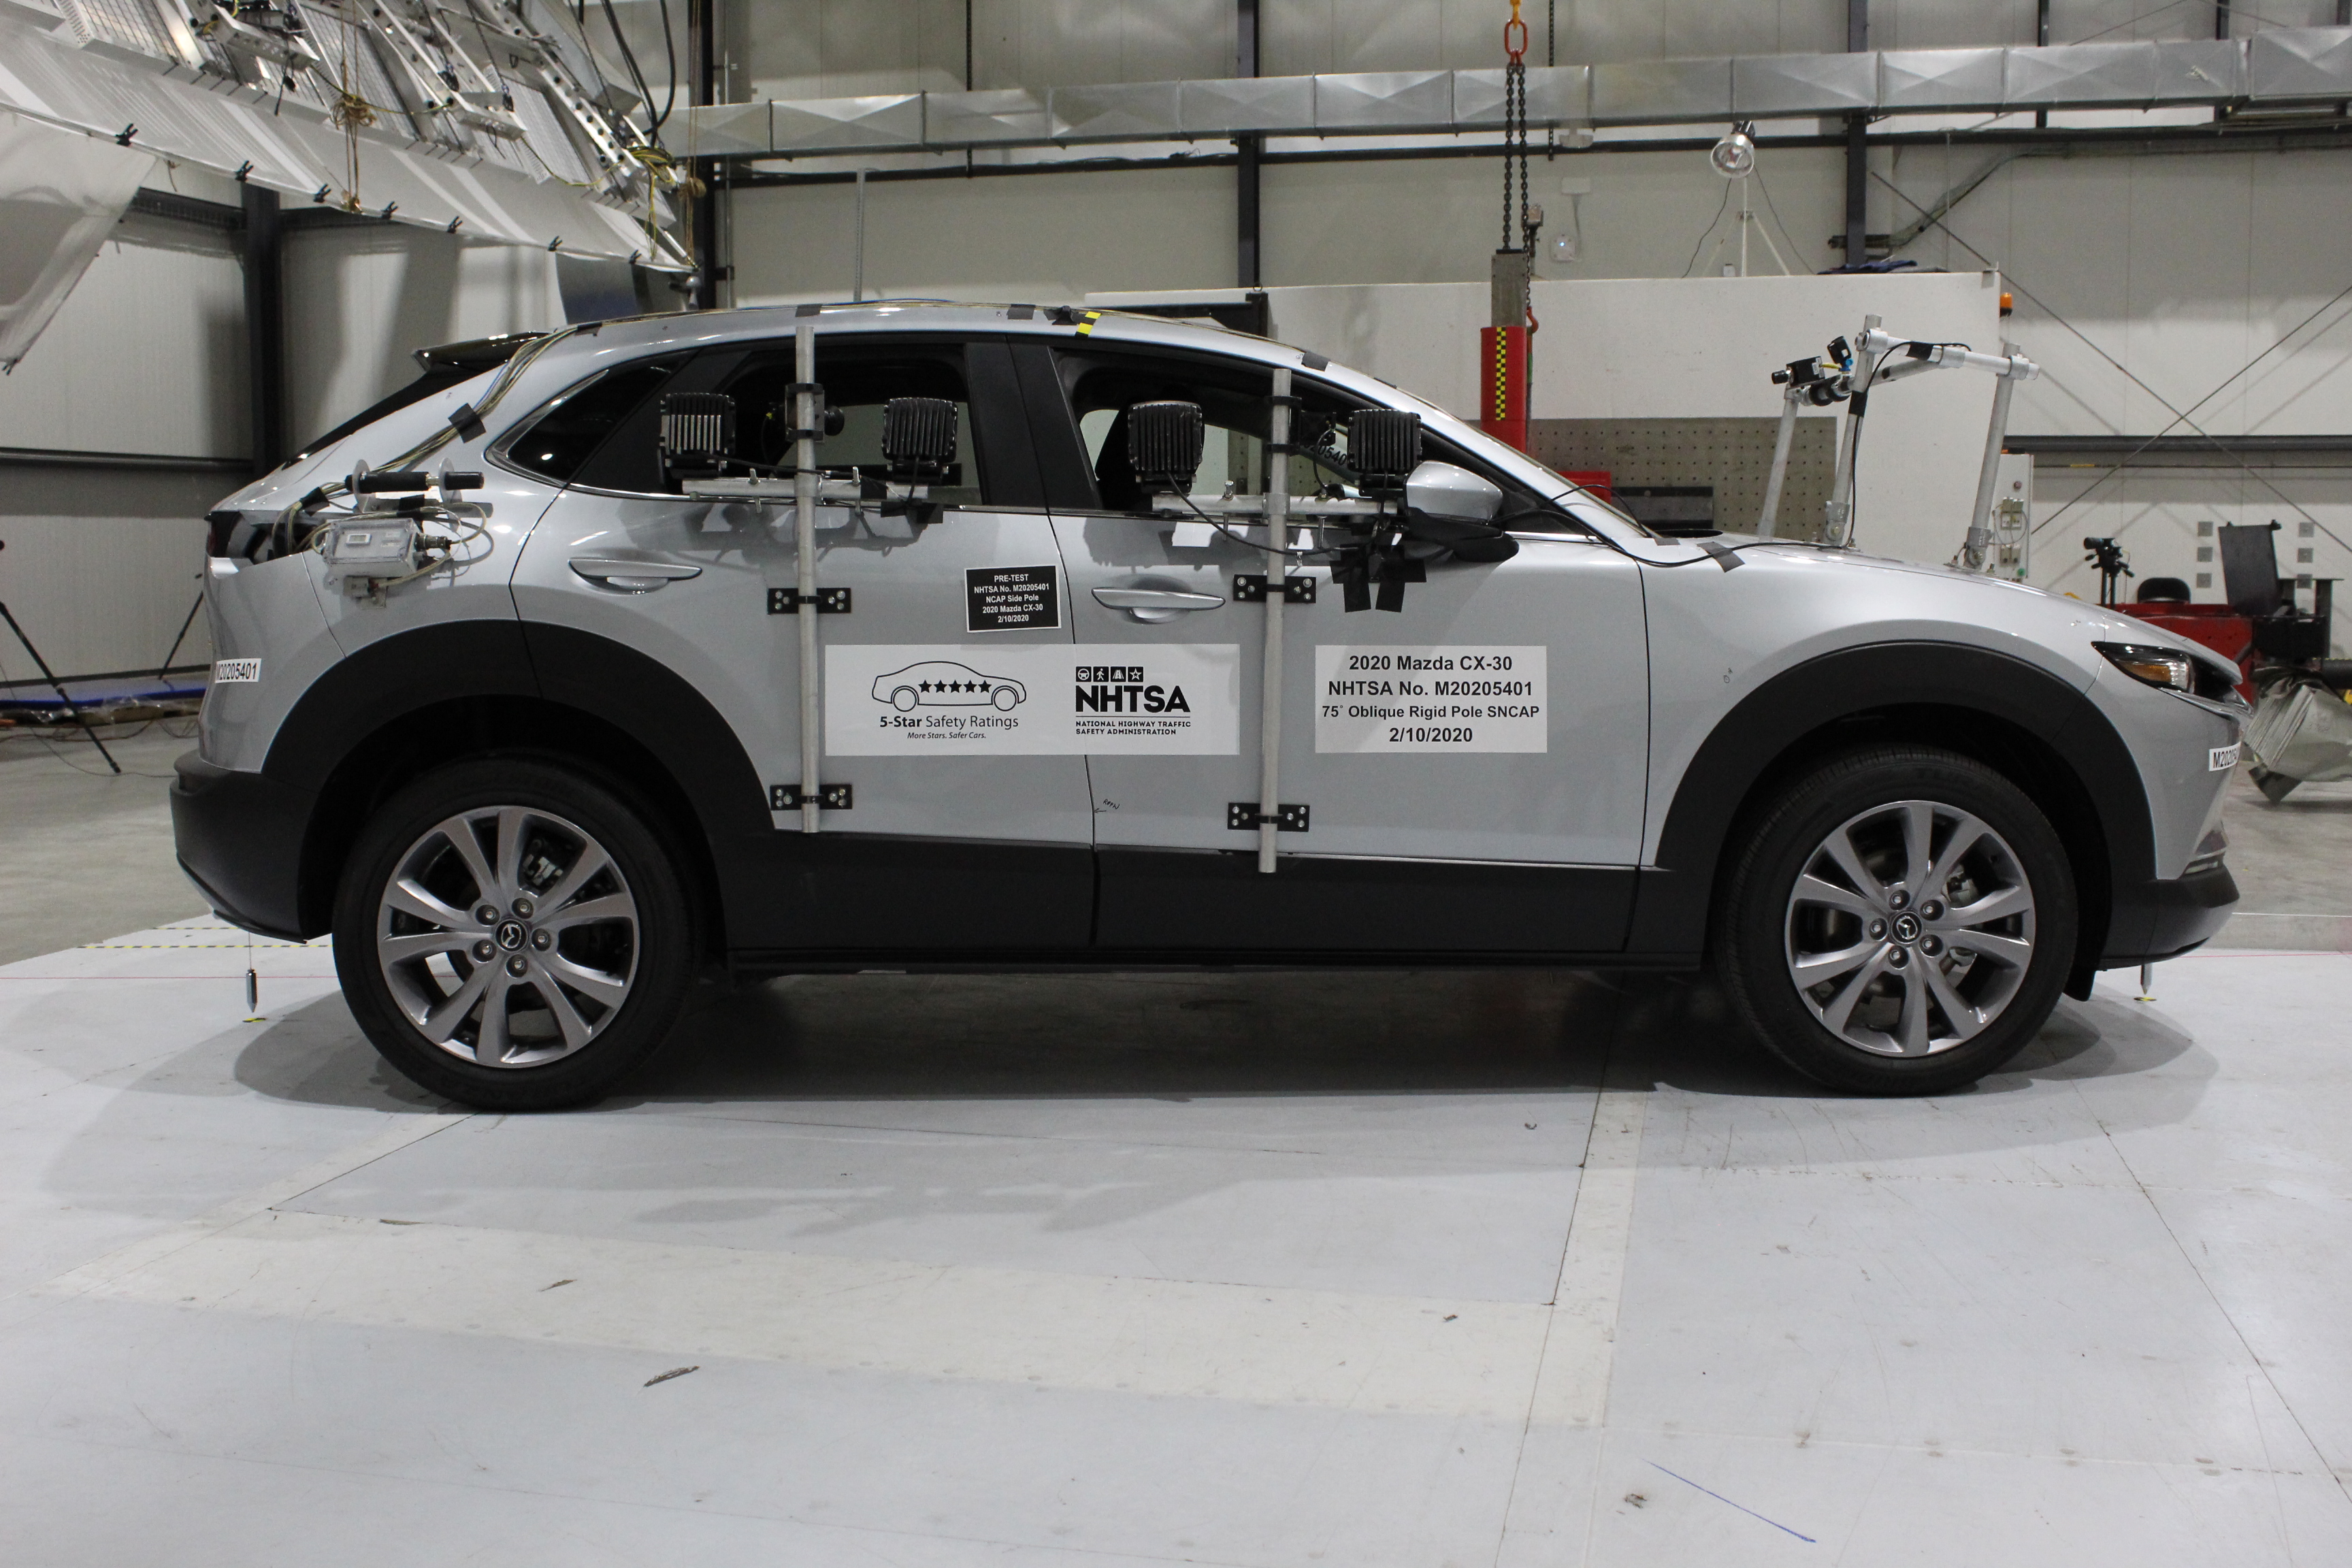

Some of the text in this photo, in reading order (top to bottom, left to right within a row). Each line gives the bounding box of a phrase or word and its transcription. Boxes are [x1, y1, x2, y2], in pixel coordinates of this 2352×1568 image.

[994, 574, 1029, 583] PRE-TEST
[974, 585, 999, 593] NHTSA
[1013, 583, 1049, 592] M20205401
[985, 595, 1006, 604] NCAP
[982, 603, 1043, 614] 2020 Mazda CX-30
[998, 614, 1029, 623] 2/10/2020
[1349, 655, 1513, 670] 2020 Mazda CX-30
[1328, 681, 1532, 696] NHTSA No. M20205401
[1075, 685, 1191, 713] NHTSA
[1348, 705, 1405, 720] Oblique
[1409, 705, 1446, 720] Rigid
[1452, 705, 1483, 718] Pole
[1487, 705, 1539, 718] SNCAP
[879, 715, 1019, 730] 5-Star Safety Ratings
[1389, 727, 1473, 742] 2/10/2020
